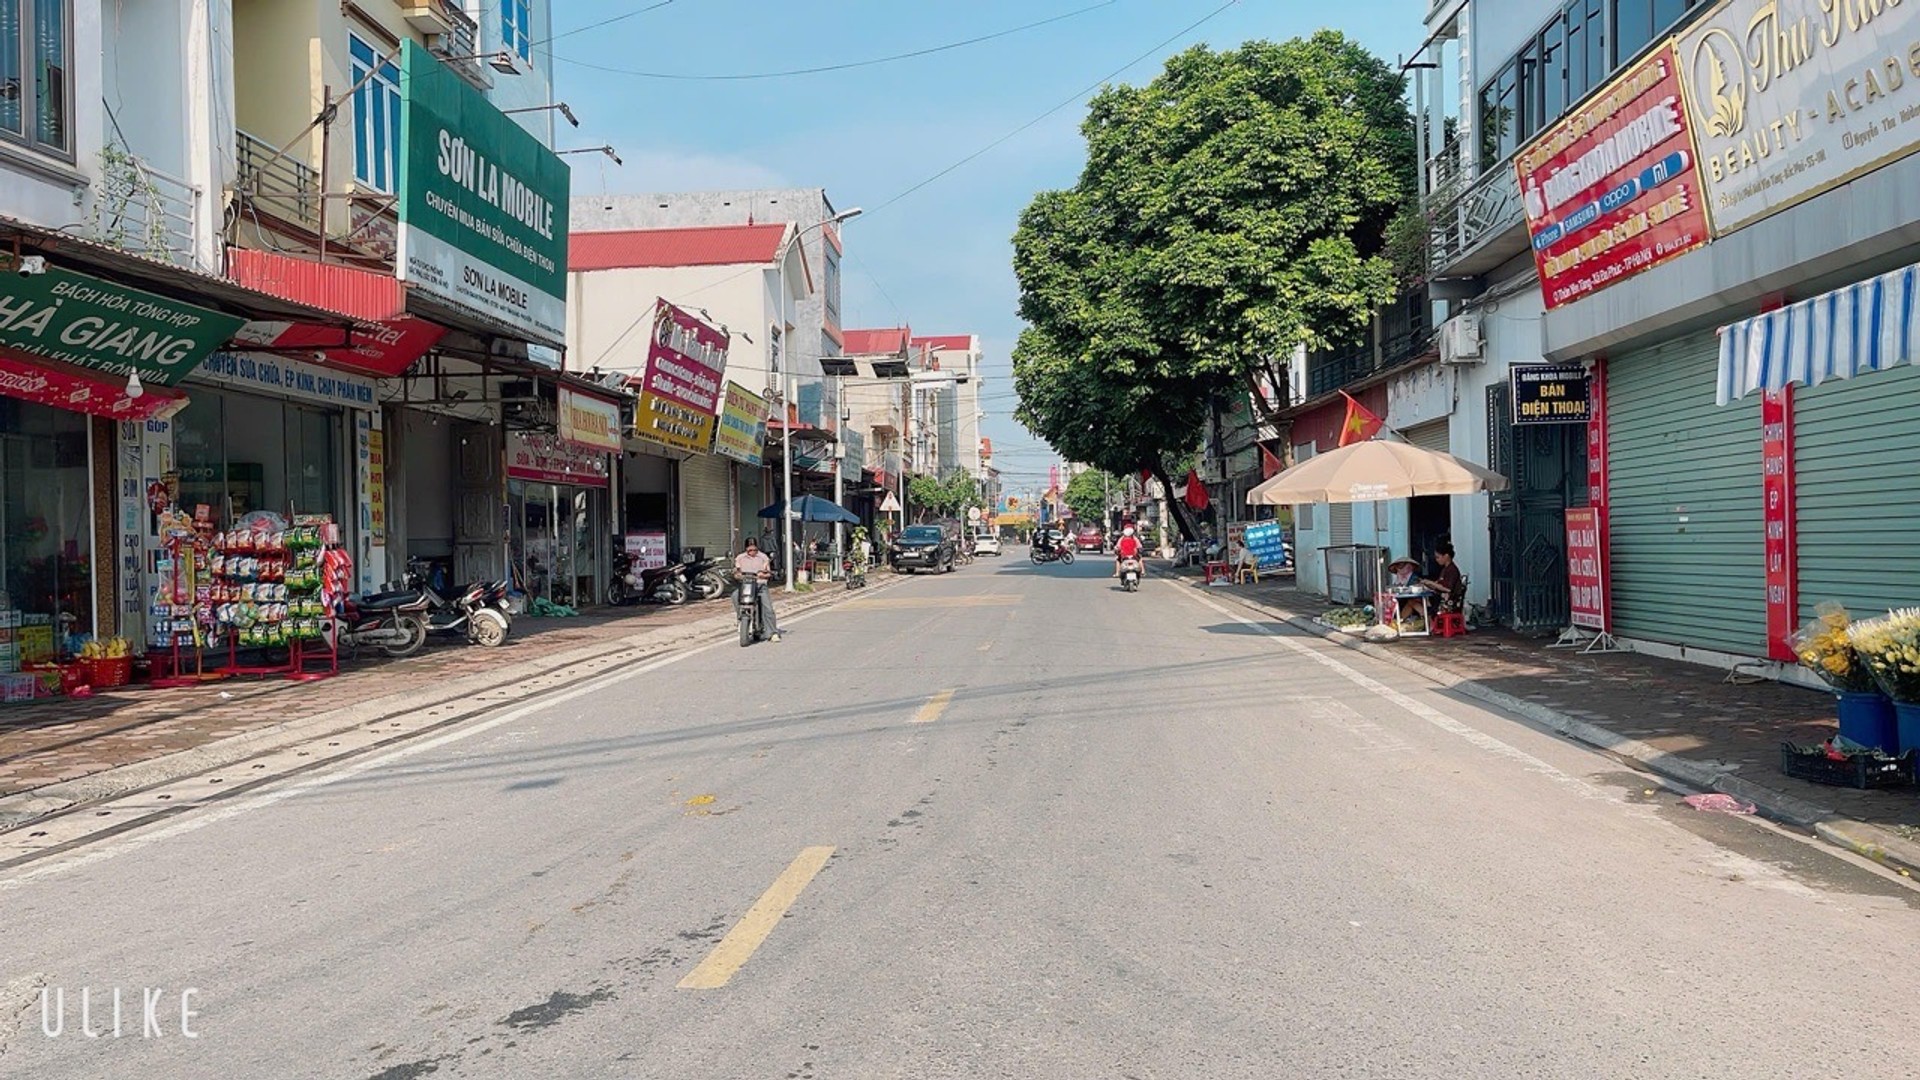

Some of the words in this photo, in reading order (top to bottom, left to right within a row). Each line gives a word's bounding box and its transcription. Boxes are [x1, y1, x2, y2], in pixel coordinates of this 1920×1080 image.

[1613, 95, 1681, 167] MOBILE
[1709, 109, 1802, 183] BEAUTY
[437, 129, 476, 192] SƠN
[478, 156, 499, 208] LA
[502, 171, 554, 241] MOBILE
[425, 190, 459, 221] CHUYÊN
[459, 209, 475, 227] MUA
[475, 218, 492, 238] BÁN
[1564, 205, 1595, 232] SAMSUNG
[51, 281, 101, 305] BÁCH
[99, 291, 132, 313] HÓA
[130, 300, 170, 321] TỔNG
[167, 311, 200, 329] HỢP
[463, 265, 483, 291] SƠN
[484, 275, 497, 297] LA
[498, 282, 528, 310] MOBILE
[0, 295, 62, 338] HÀ
[60, 317, 196, 366] GIANG
[284, 364, 296, 388] ÉP
[1540, 382, 1565, 397] BÁN
[146, 416, 169, 433] GÓP
[1521, 399, 1549, 418] ĐIỆN
[1552, 400, 1586, 417] THOẠI
[1582, 525, 1596, 547] BÁN
